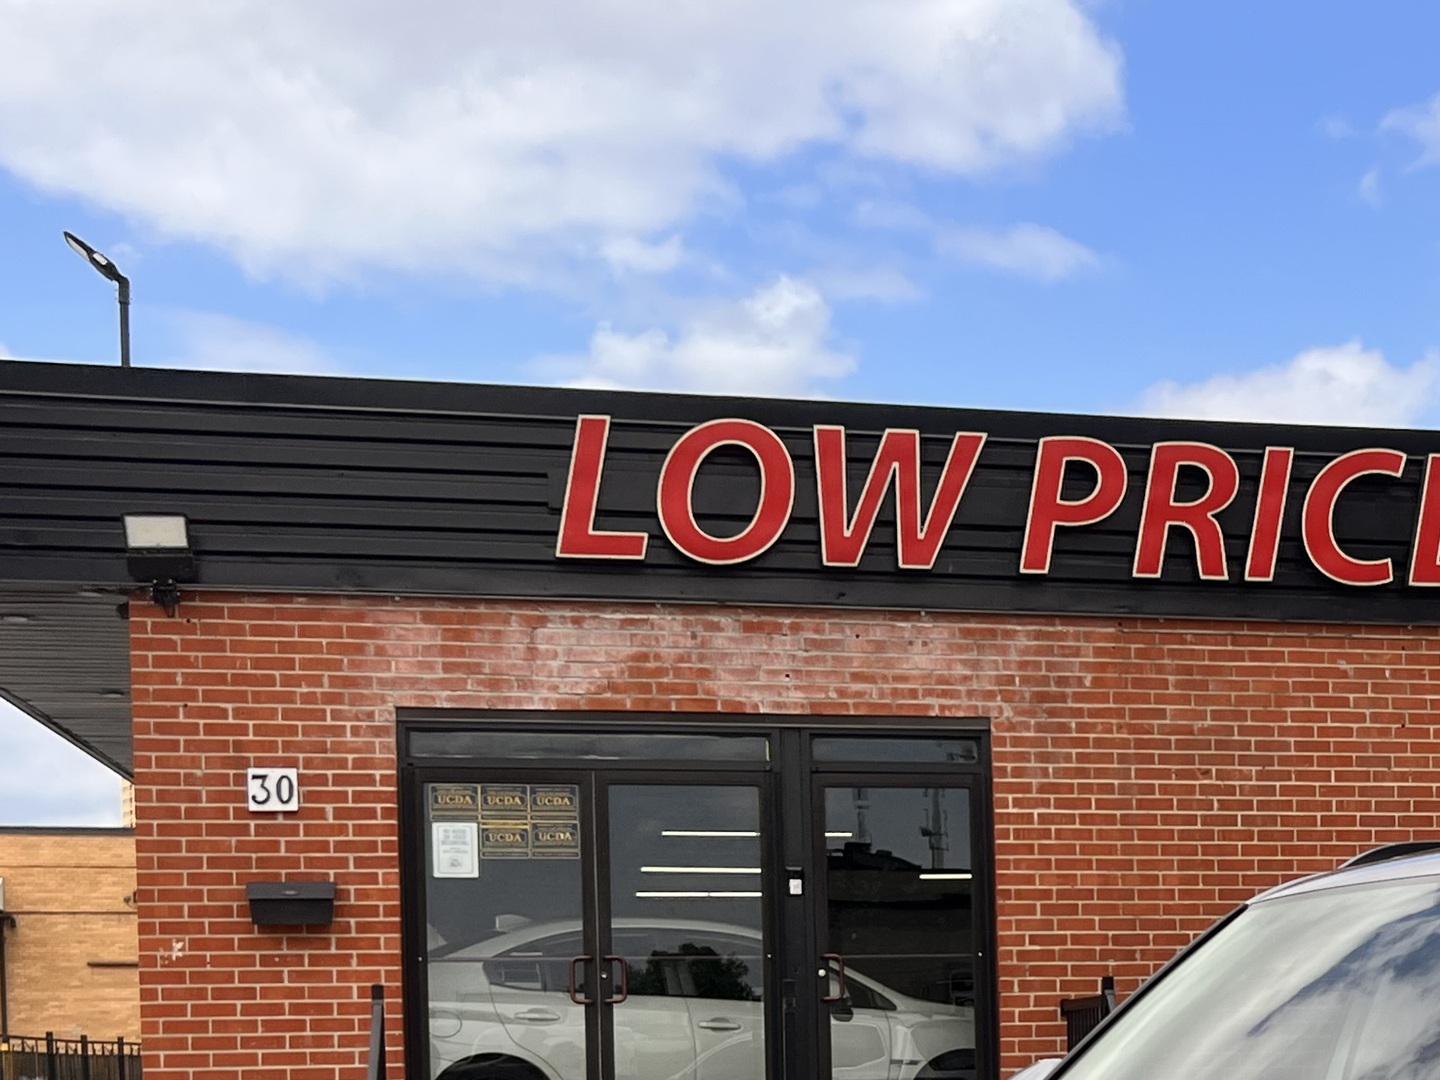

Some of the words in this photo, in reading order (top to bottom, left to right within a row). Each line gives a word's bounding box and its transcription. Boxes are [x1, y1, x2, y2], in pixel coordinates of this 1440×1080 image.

[555, 414, 988, 569] LOW
[251, 774, 294, 805] 30
[437, 794, 473, 805] UCDA
[487, 795, 522, 806] UCDA
[537, 796, 571, 807] UCDA
[488, 832, 522, 843] UCDA
[538, 831, 572, 842] UCDA
